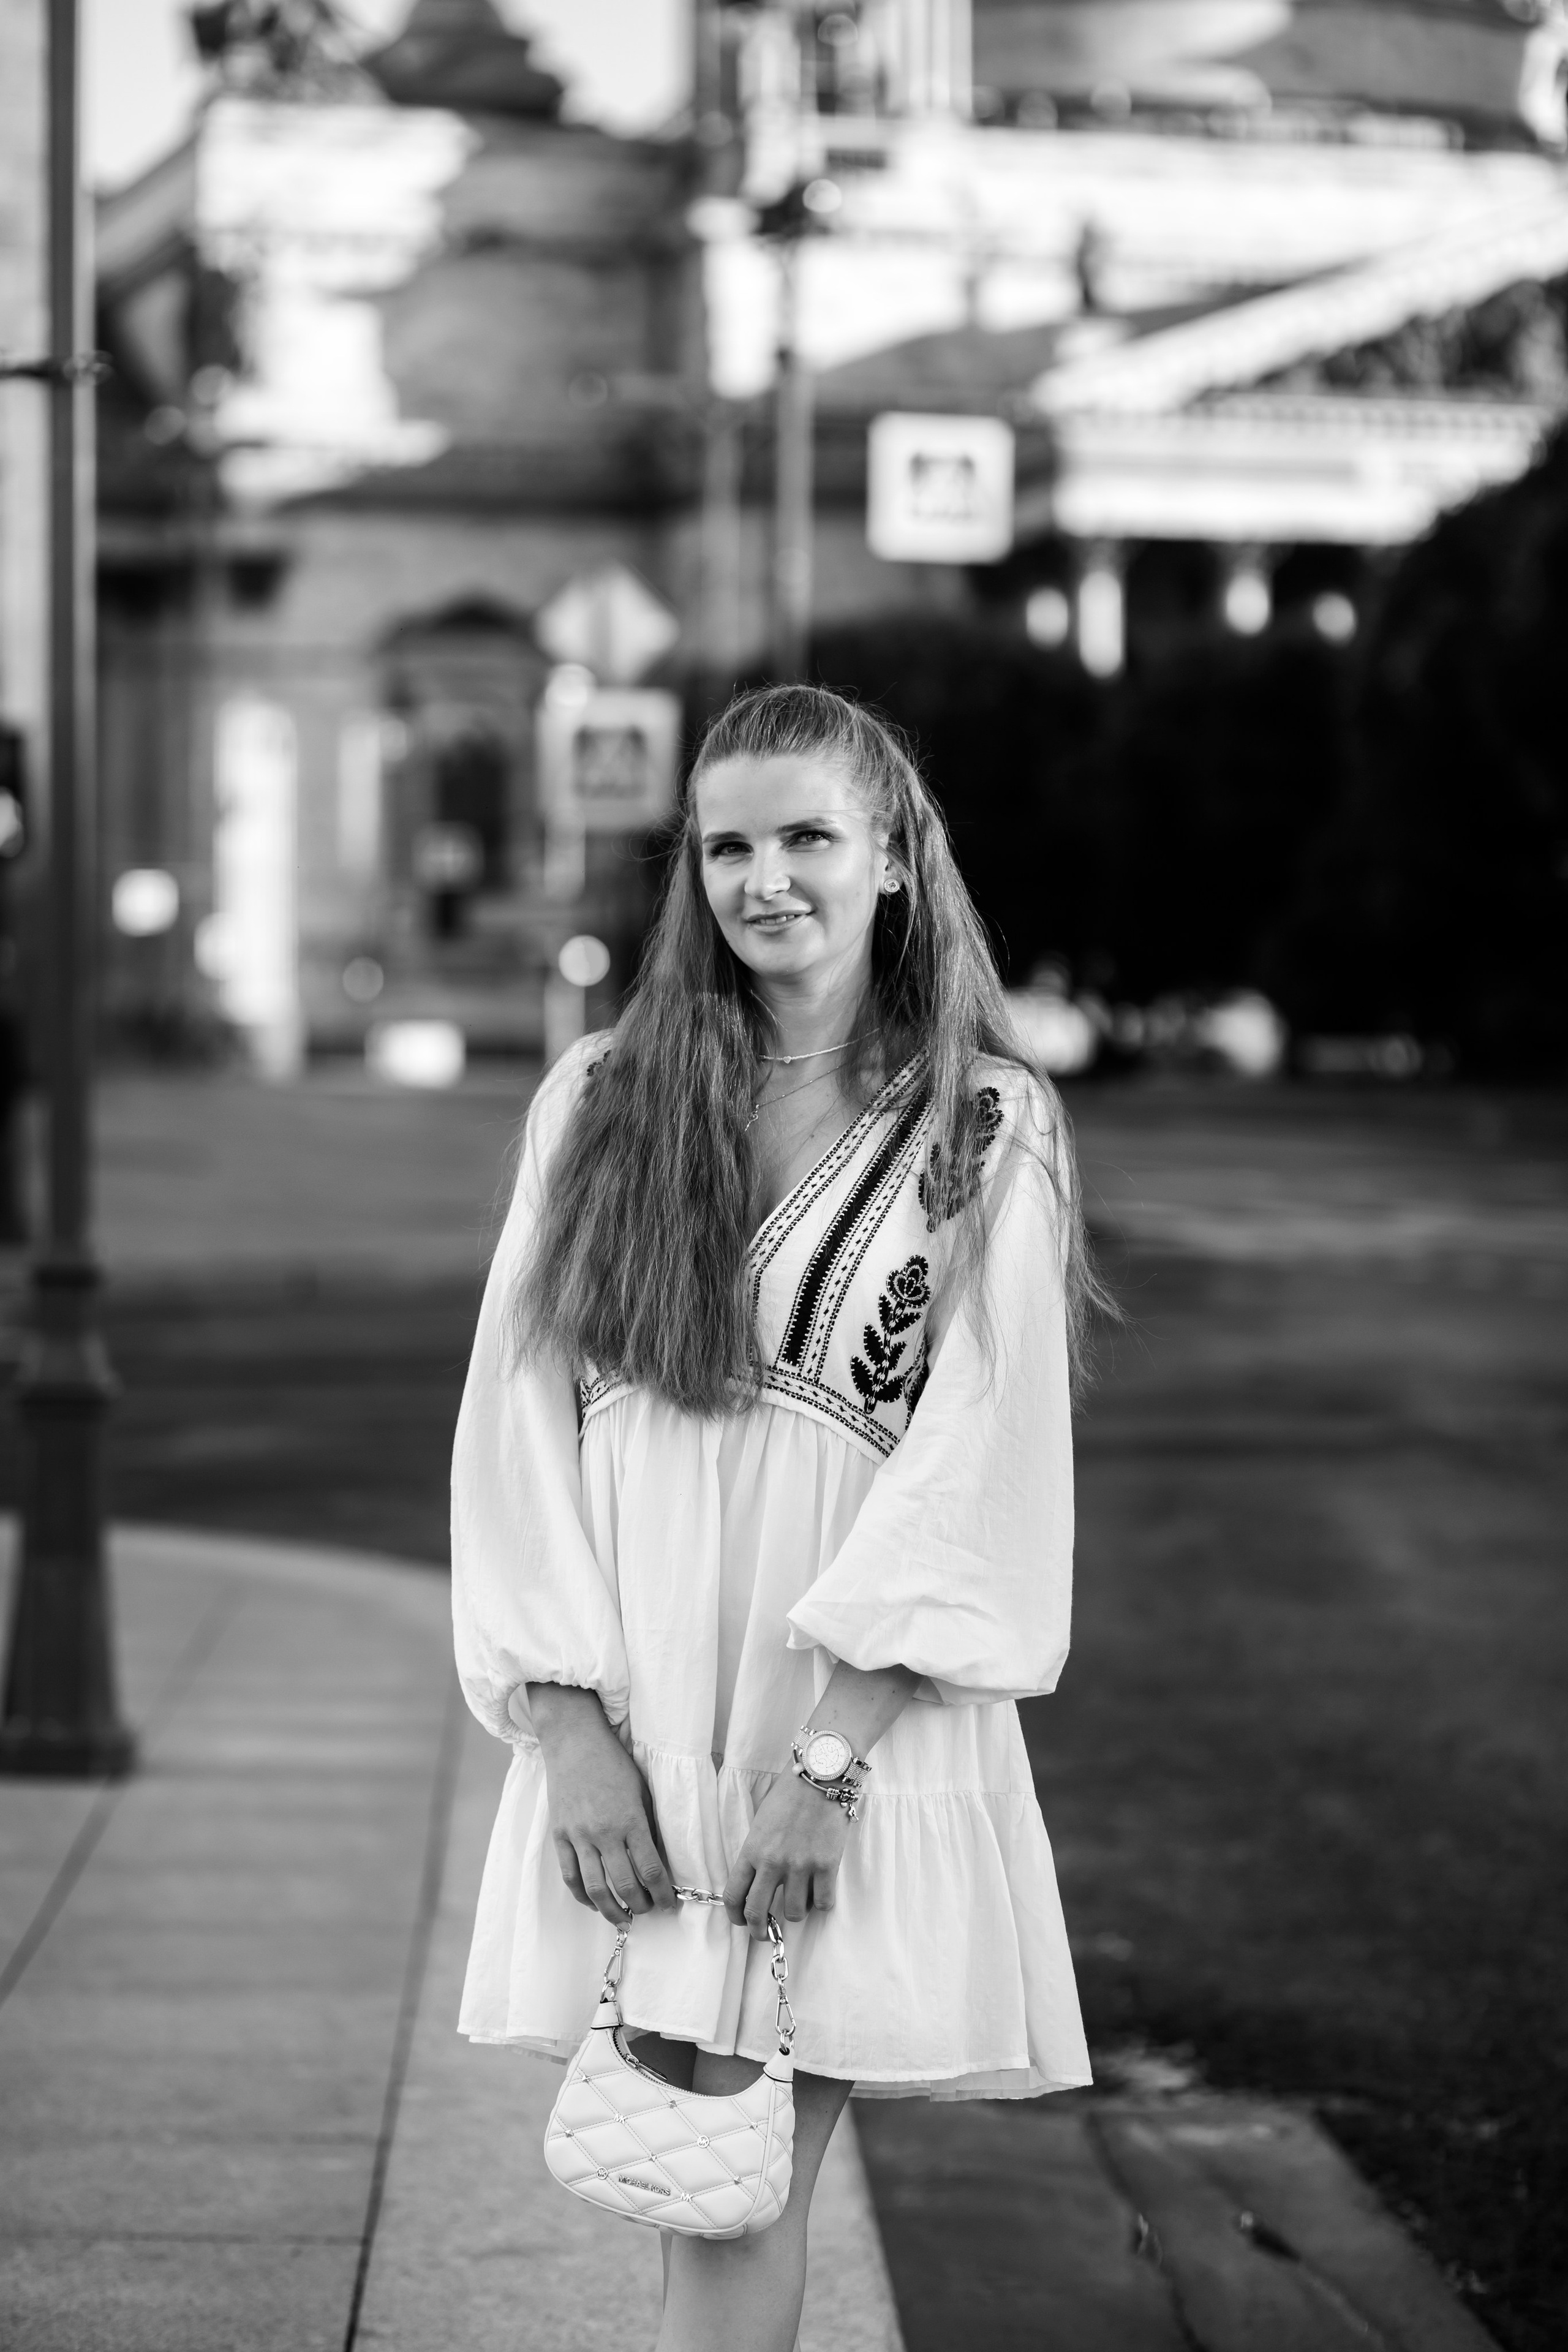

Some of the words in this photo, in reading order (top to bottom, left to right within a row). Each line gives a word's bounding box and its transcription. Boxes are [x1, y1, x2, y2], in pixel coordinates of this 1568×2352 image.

[614, 2113, 627, 2124] MK
[618, 2174, 650, 2191] MICHAEL
[650, 2184, 671, 2196] KORS
[680, 2192, 693, 2202] MK
